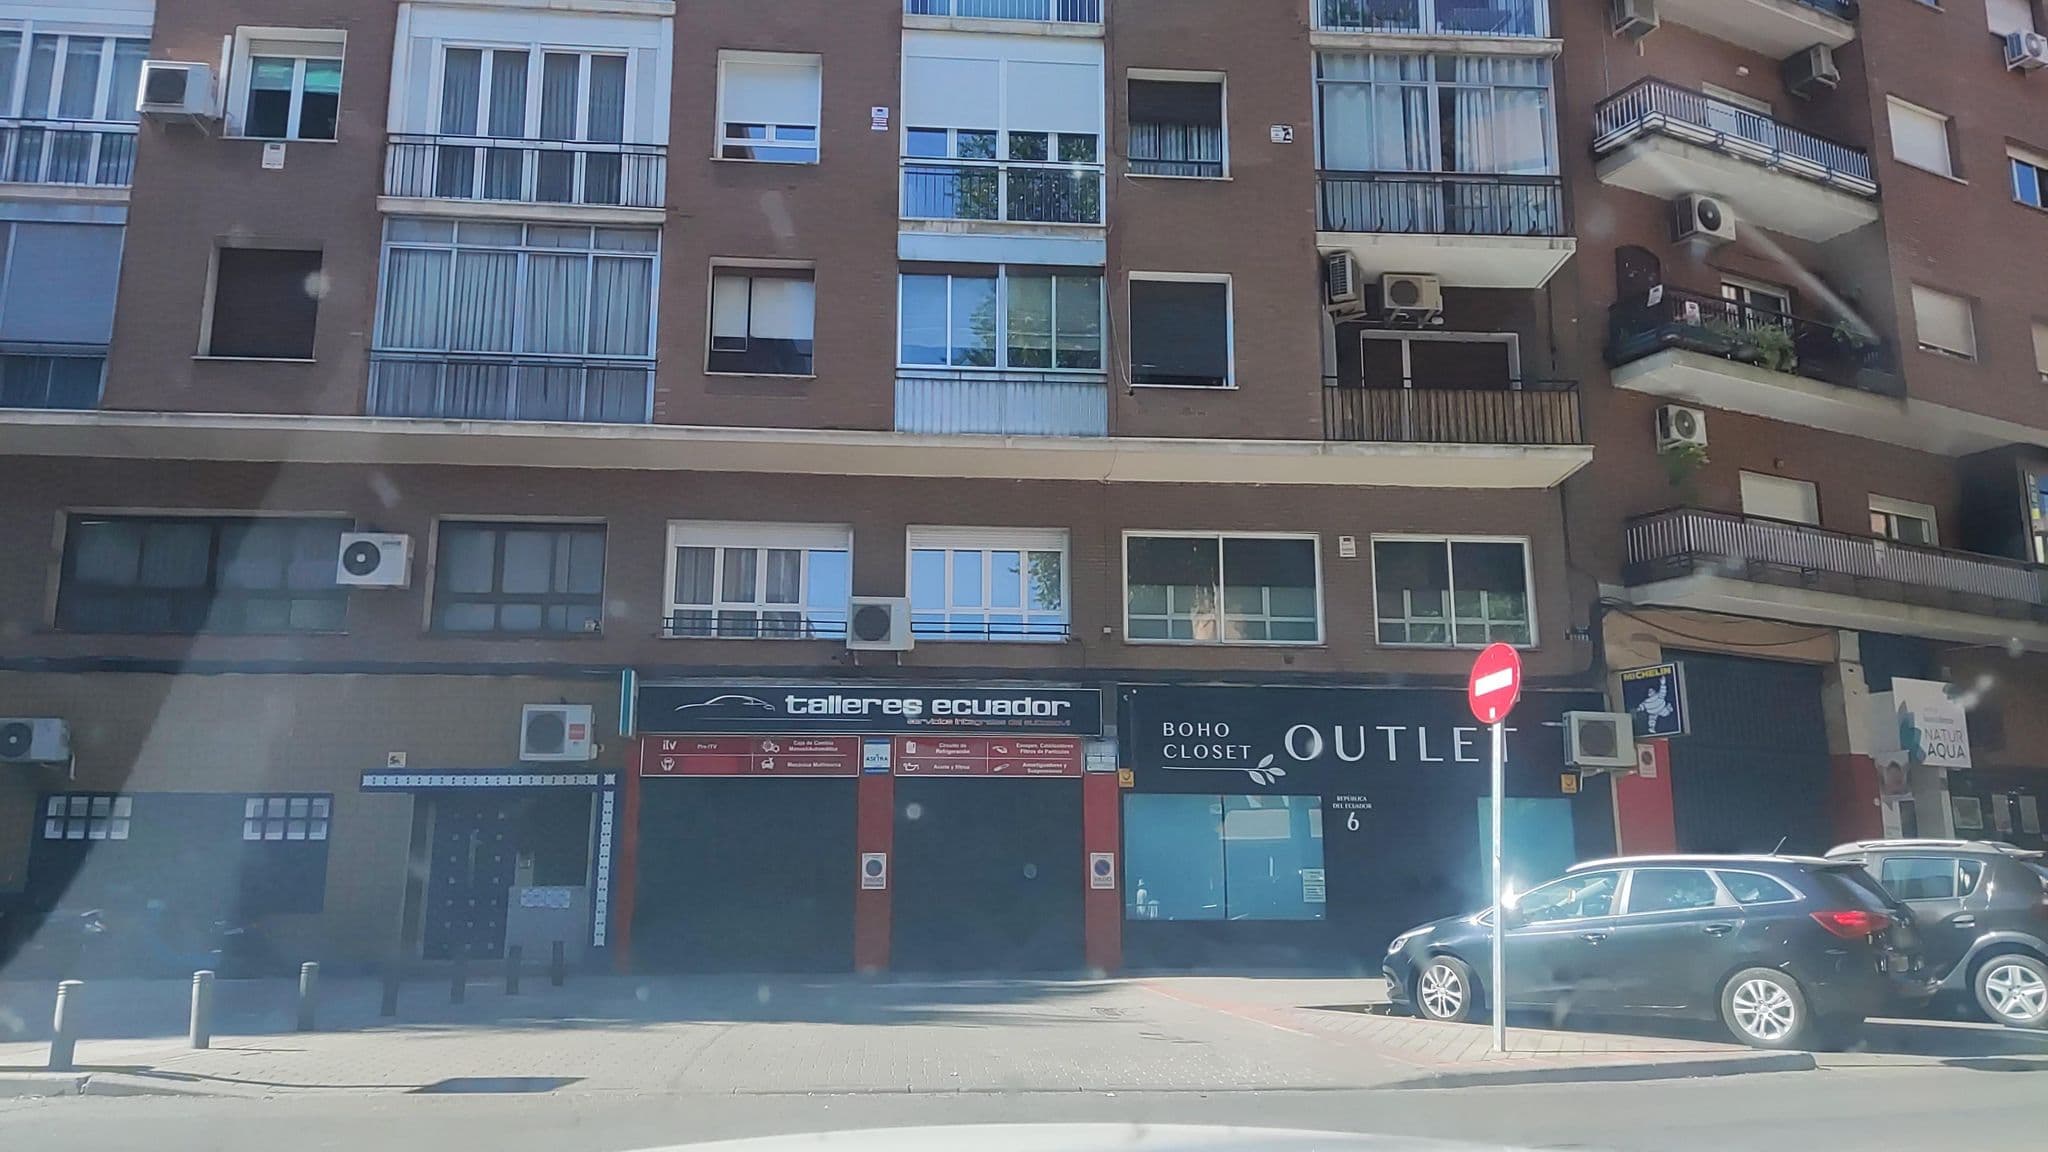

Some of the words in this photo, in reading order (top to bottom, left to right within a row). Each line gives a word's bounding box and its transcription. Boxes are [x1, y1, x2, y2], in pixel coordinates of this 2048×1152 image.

[1623, 666, 1672, 681] MICHELIN
[784, 695, 922, 714] talleres
[931, 697, 1071, 716] ecuador
[1163, 722, 1230, 738] BOHO
[1924, 728, 1964, 743] NATUR
[1163, 744, 1252, 760] CLOSET
[1284, 724, 1518, 763] OUTLET
[1927, 742, 1966, 760] AQUA
[1347, 811, 1360, 831] 6
